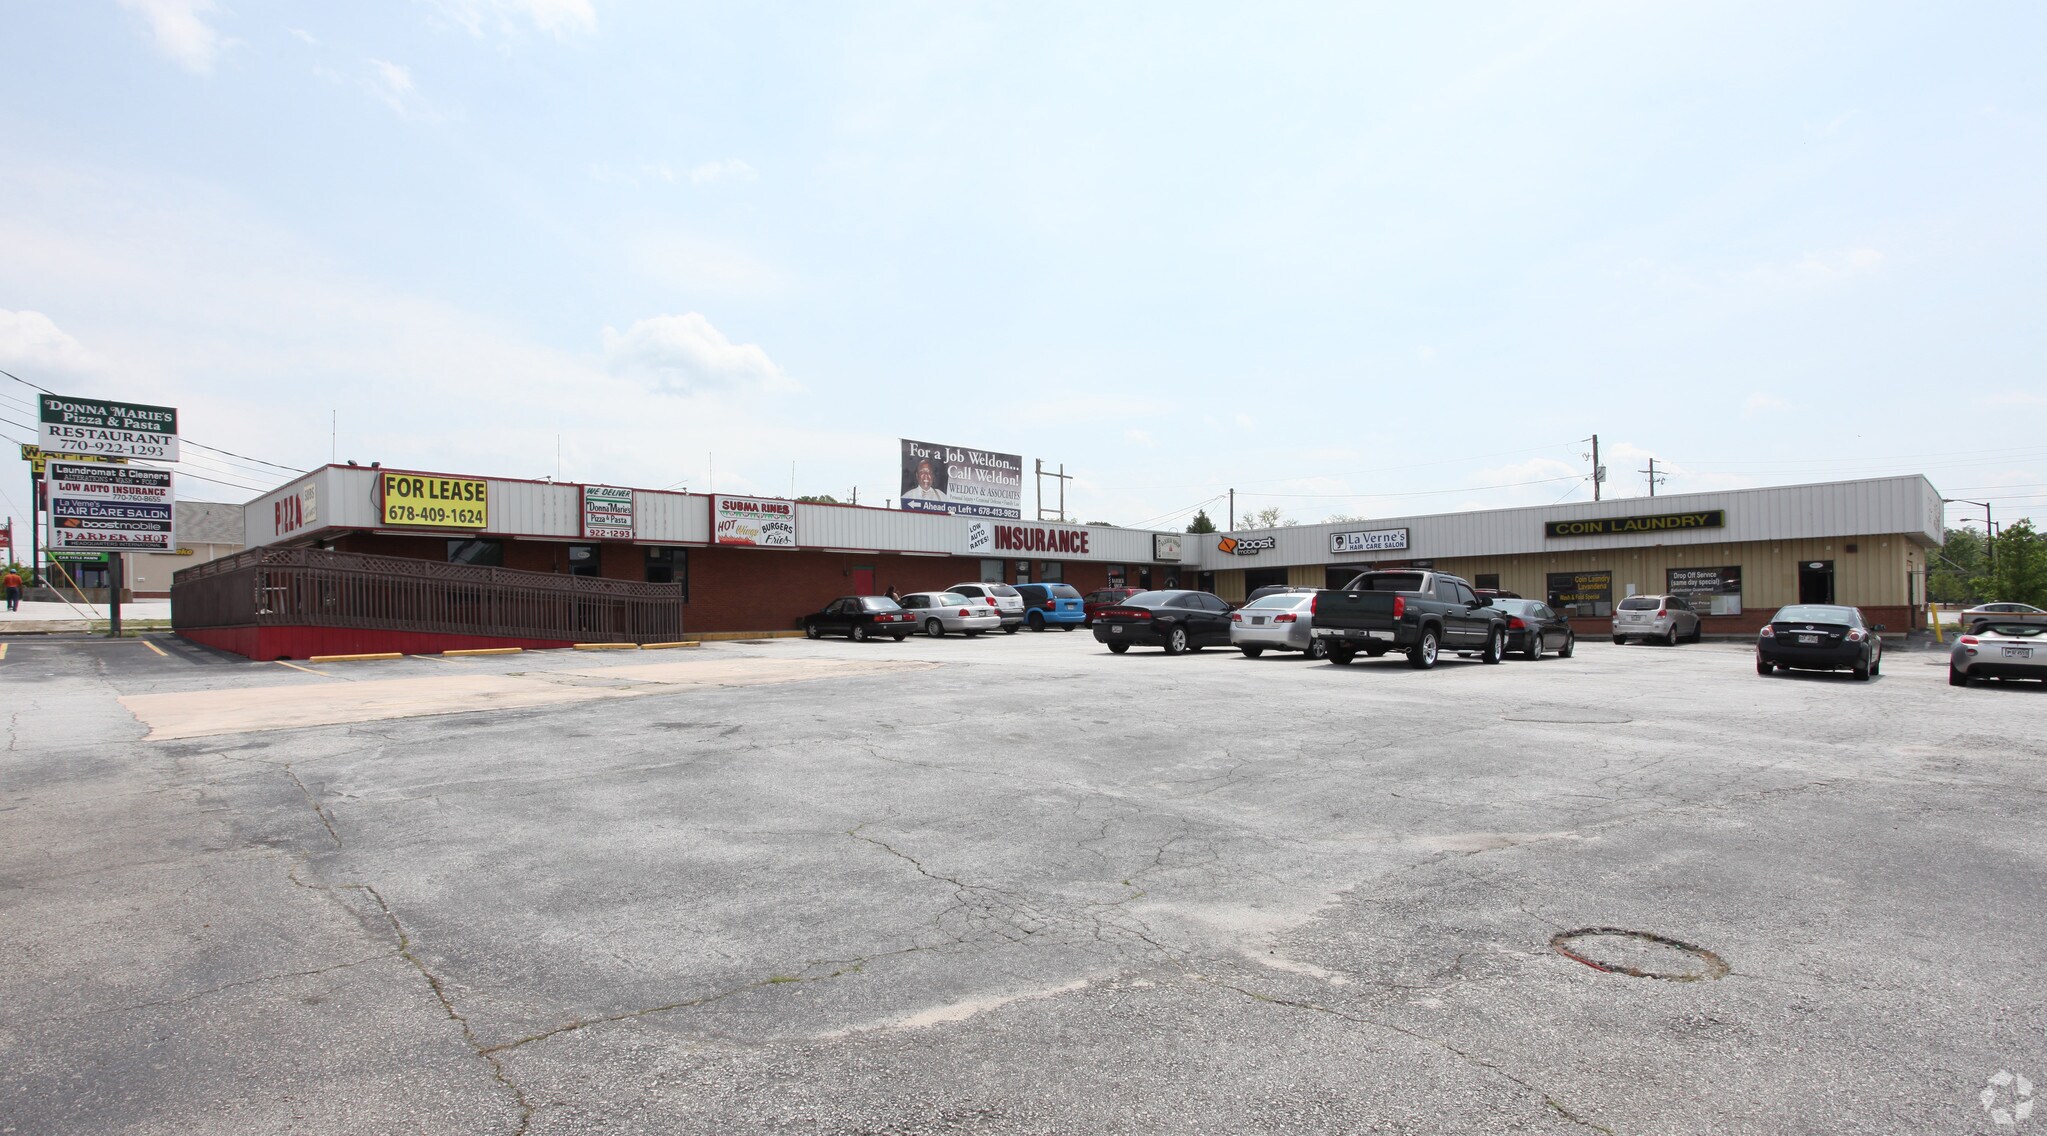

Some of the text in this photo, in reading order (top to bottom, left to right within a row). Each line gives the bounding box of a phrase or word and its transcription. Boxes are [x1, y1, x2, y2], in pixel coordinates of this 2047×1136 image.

[45, 400, 173, 422] DONNA MARIE'S
[63, 412, 161, 431] Pizza & Pasta
[48, 425, 173, 446] RESTAURANT
[60, 438, 164, 457] 770-922-1293
[909, 442, 1019, 471] For a Job Weldon...
[56, 464, 117, 477] Laundromat
[118, 469, 127, 477] &
[128, 470, 169, 481] Cleaners
[947, 465, 1019, 486] Call Weldon!
[59, 482, 166, 496] LOW AUTO INSURANCE
[386, 477, 485, 502] FOR LEASE
[586, 487, 631, 497] WE DELIVER
[949, 482, 1021, 501] WELDON & ASSOCIATES
[57, 506, 169, 519] HAIR CARE SALON
[587, 501, 609, 512] Donna
[922, 501, 946, 512] Ahead
[947, 505, 957, 513] on
[958, 504, 972, 514] Left
[275, 493, 303, 536] PIZZA
[389, 505, 483, 524] 678-409-1624
[591, 514, 606, 523] Pizza
[611, 515, 627, 524] Pasta
[717, 520, 738, 533] HOT
[761, 522, 793, 534] BURGERS
[969, 522, 981, 533] LOW
[1555, 514, 1709, 535] COIN LAUNDRY
[64, 531, 169, 543] BARBER SHOP
[589, 529, 630, 538] 922-1293
[765, 534, 792, 545] Fries
[970, 529, 985, 541] AUTO
[994, 525, 1090, 554] INSURANCE
[1348, 531, 1405, 545] La Verne's
[969, 535, 990, 550] RATES!
[1237, 536, 1274, 549] boost
[1384, 541, 1404, 549] SALON
